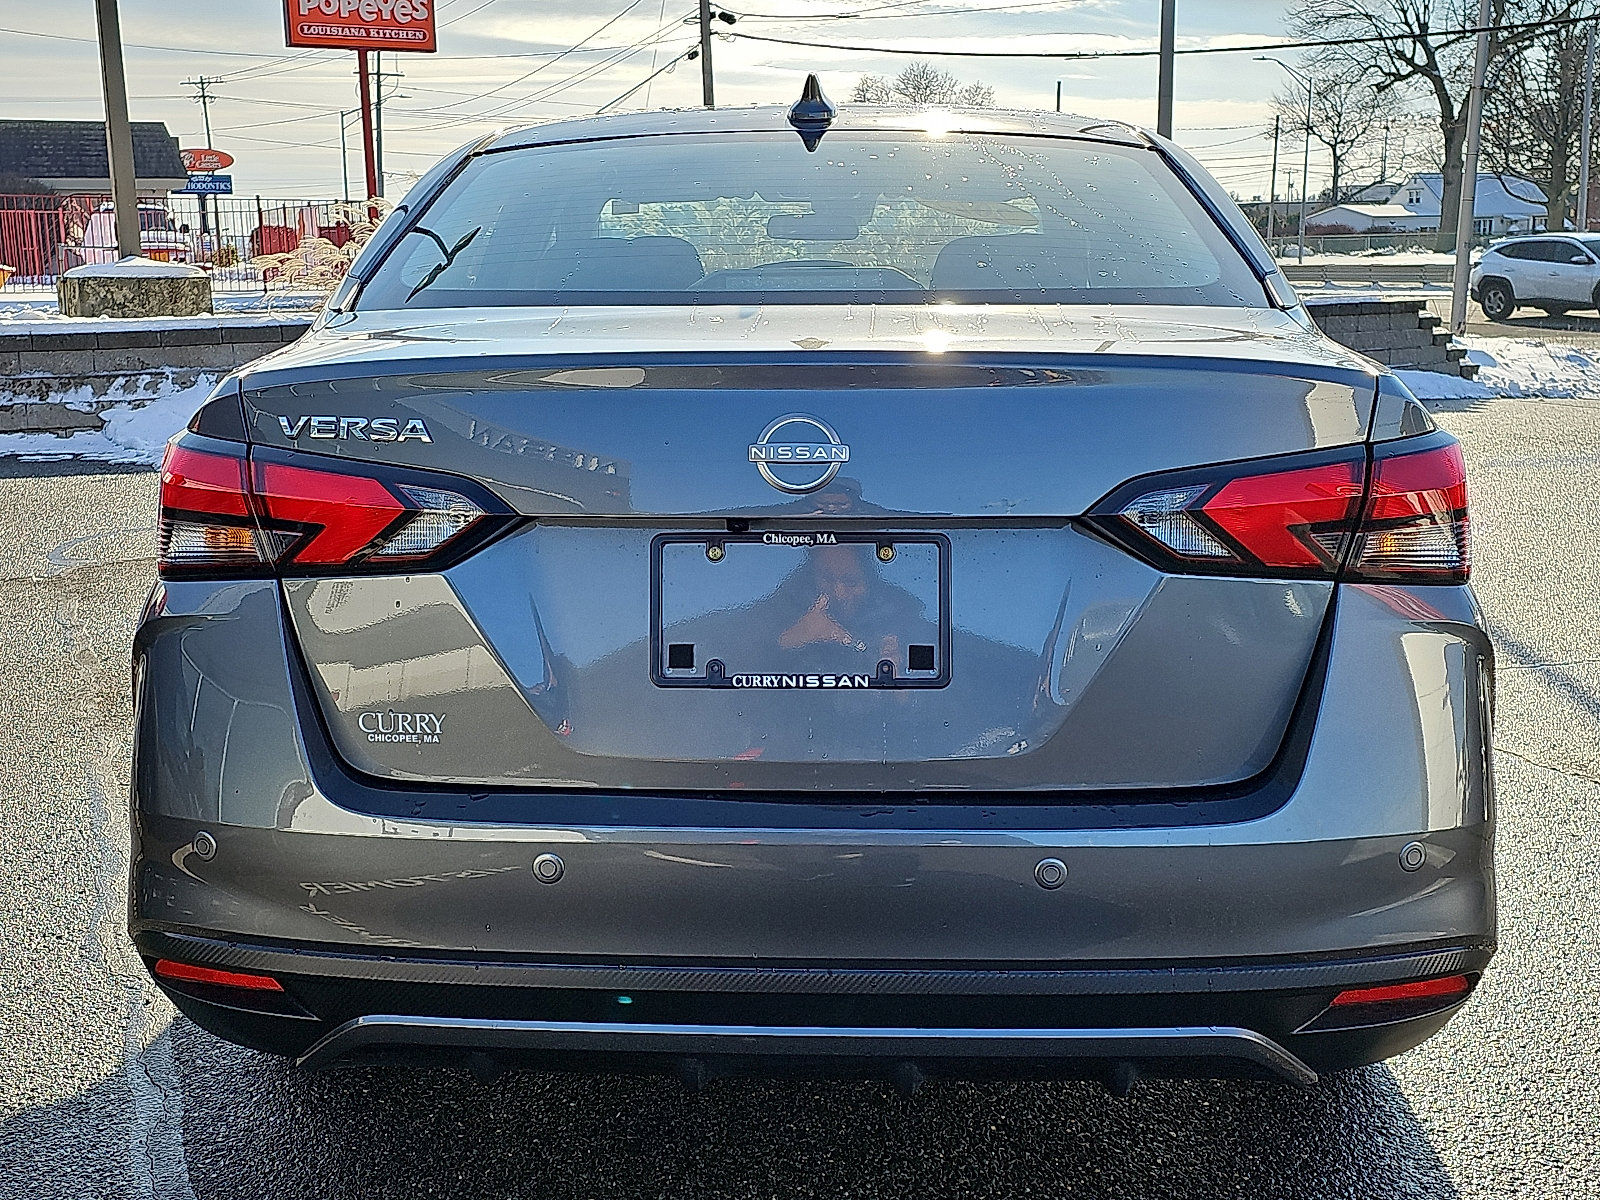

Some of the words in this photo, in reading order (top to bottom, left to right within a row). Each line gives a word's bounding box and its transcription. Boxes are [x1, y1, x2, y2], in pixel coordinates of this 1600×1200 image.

[302, 25, 367, 37] LOUISIANA
[369, 28, 424, 40] KITCHEN
[277, 415, 434, 443] VERSA
[751, 446, 847, 459] NISSAN
[762, 532, 815, 546] Chicopee,
[816, 533, 837, 544] MA
[358, 711, 446, 734] CURRY
[367, 734, 422, 744] CHICOPEE,
[424, 735, 440, 743] MA
